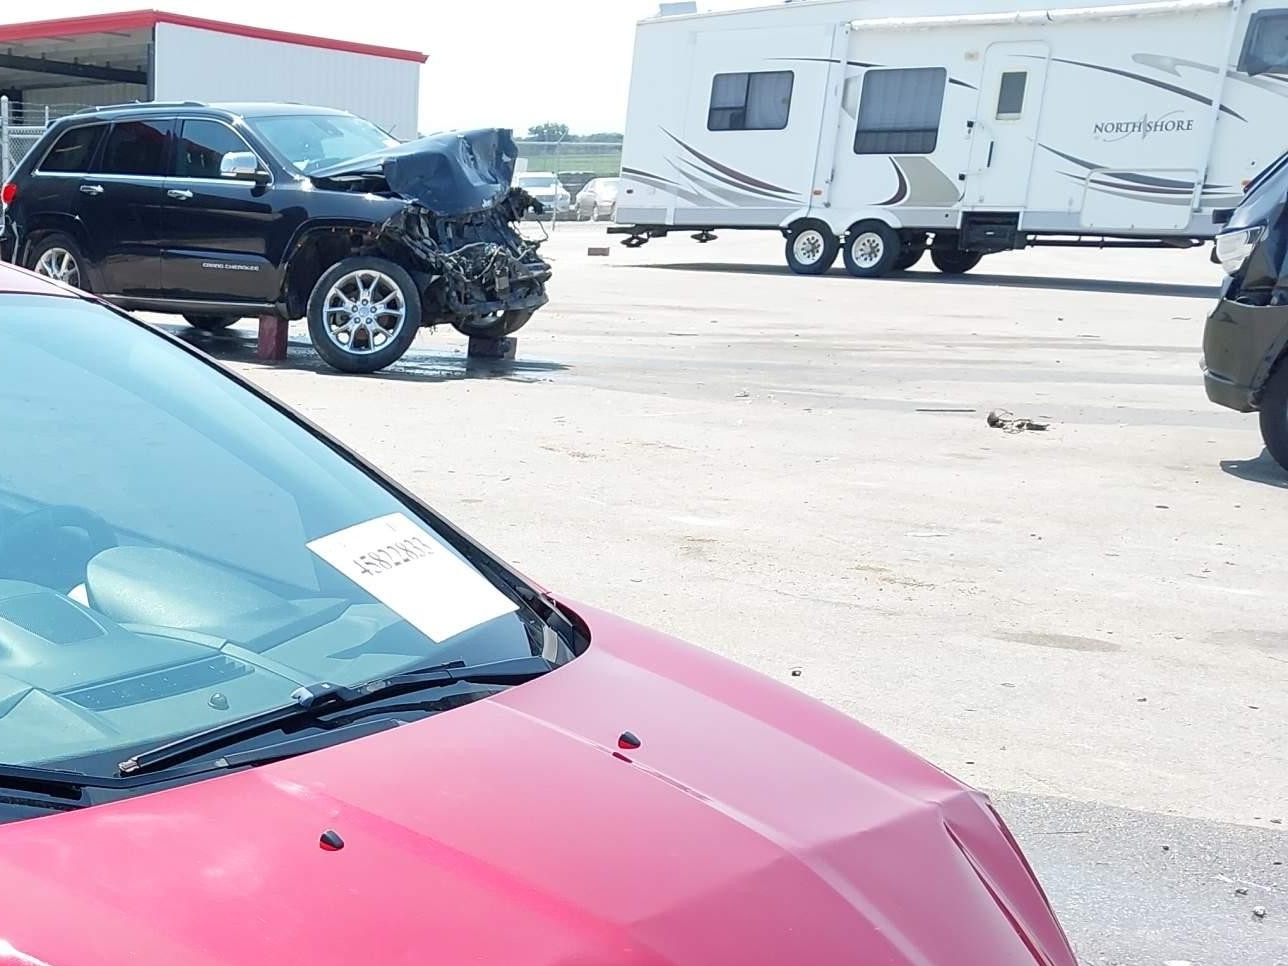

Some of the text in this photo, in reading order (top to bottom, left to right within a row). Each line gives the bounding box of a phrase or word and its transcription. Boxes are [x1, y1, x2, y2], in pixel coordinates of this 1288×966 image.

[1093, 119, 1194, 133] NORTH SHORE
[353, 537, 435, 576] 45822833
